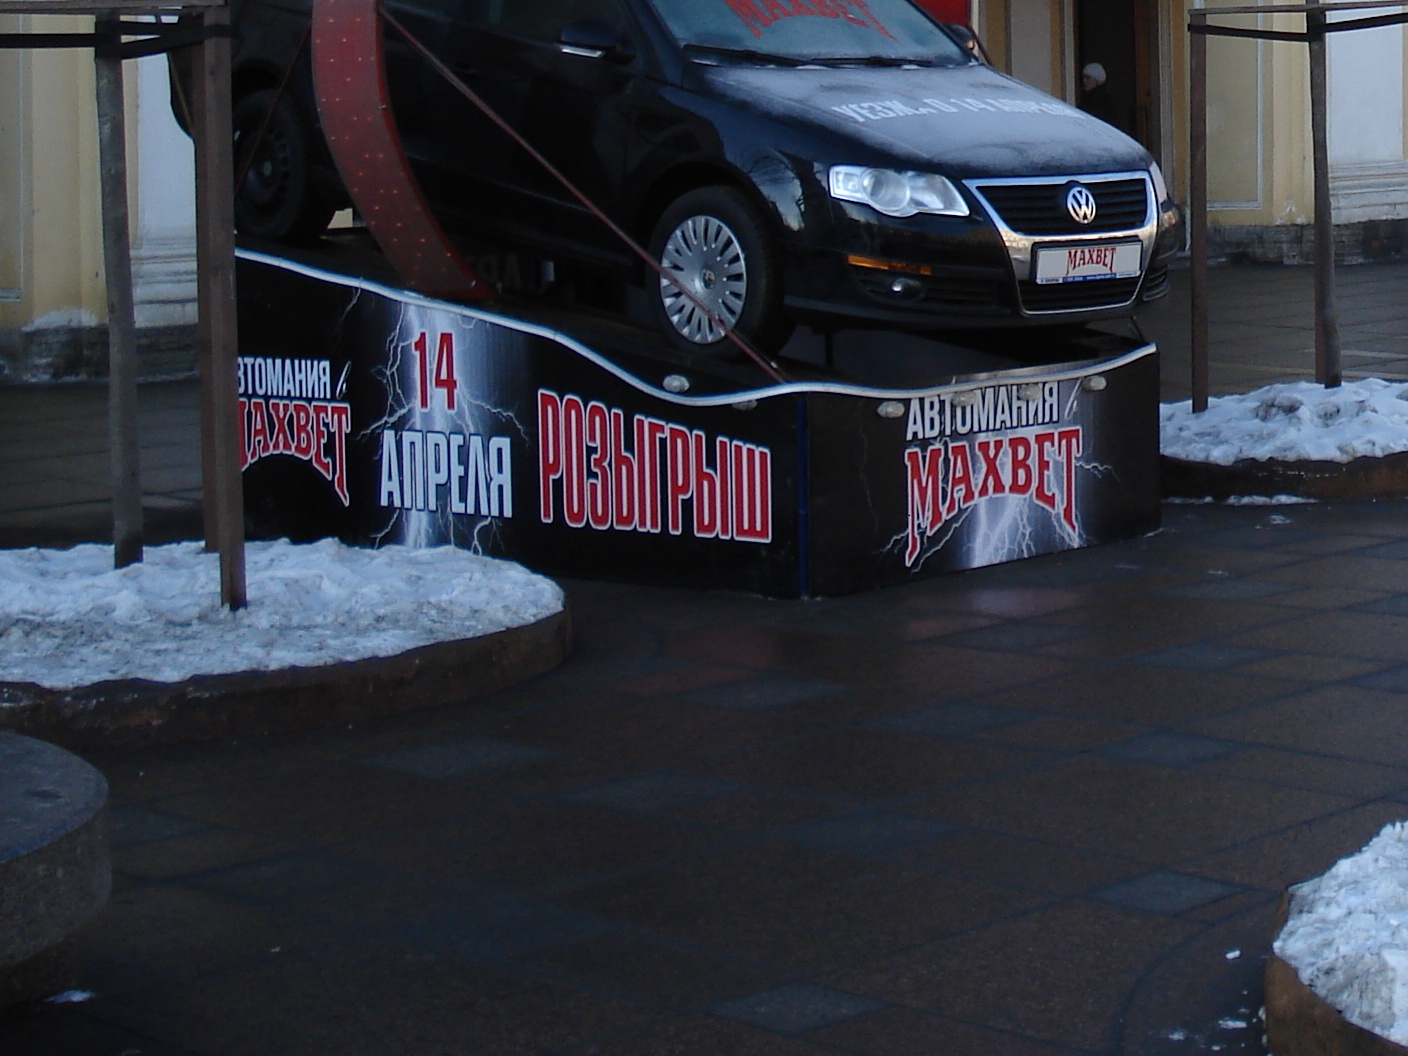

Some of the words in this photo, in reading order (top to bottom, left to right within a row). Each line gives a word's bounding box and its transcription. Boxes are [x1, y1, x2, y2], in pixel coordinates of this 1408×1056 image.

[1065, 247, 1117, 276] MAXBET
[238, 357, 331, 399] ВТОМАНИЯ
[413, 330, 458, 413] 14
[906, 381, 1060, 441] АВТОМАНИЯ
[380, 429, 513, 519] АПРЕЛЯ
[538, 388, 772, 543] РОЗЫГРЫШ
